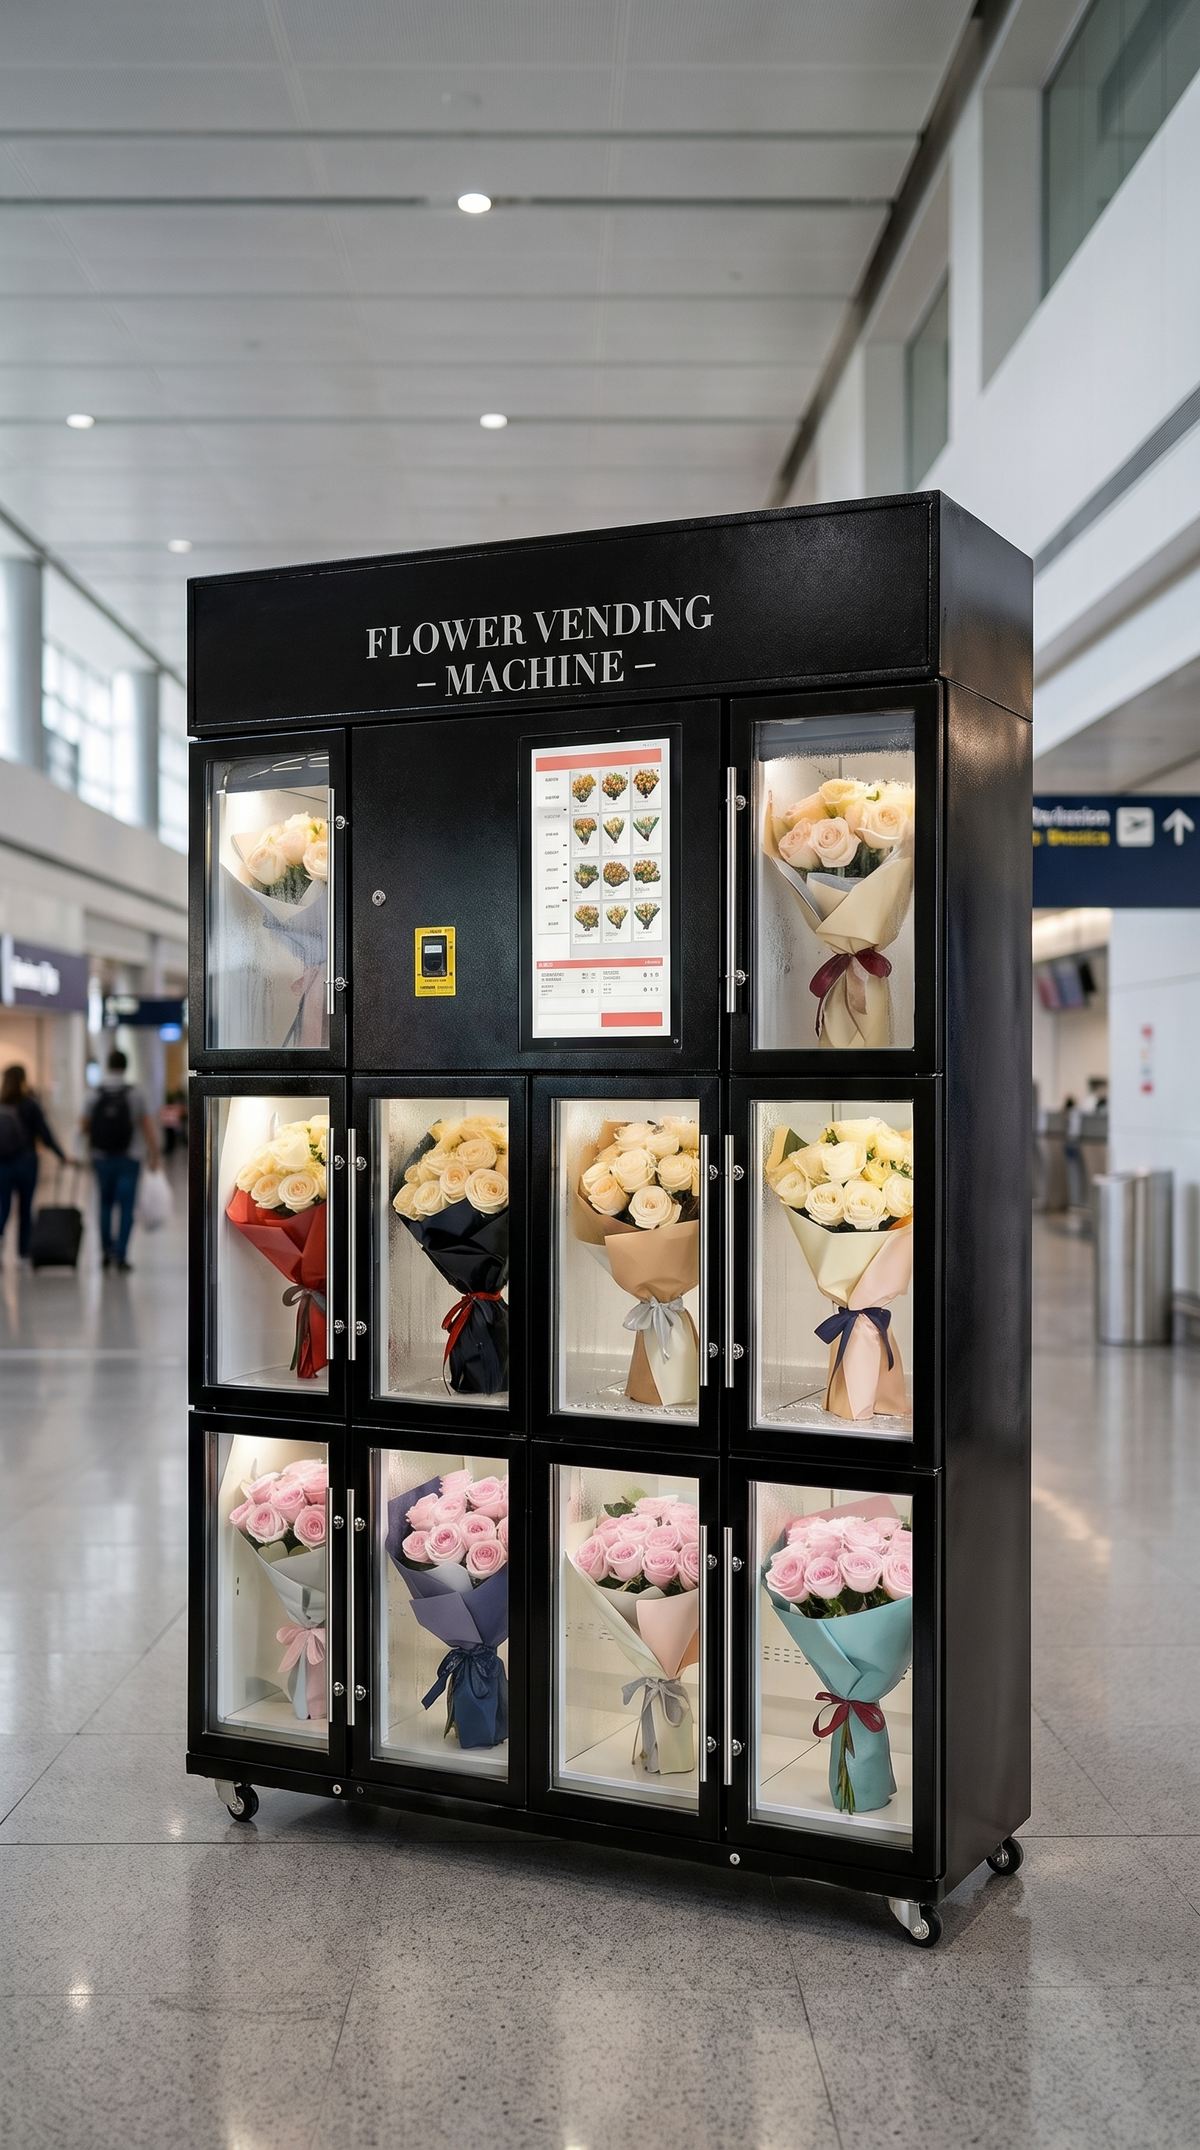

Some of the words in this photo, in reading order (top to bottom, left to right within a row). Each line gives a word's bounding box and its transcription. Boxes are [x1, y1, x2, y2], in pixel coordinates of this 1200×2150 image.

[366, 615, 527, 660] FLOWER
[533, 595, 714, 643] VENDING
[445, 650, 625, 697] MACHINE
